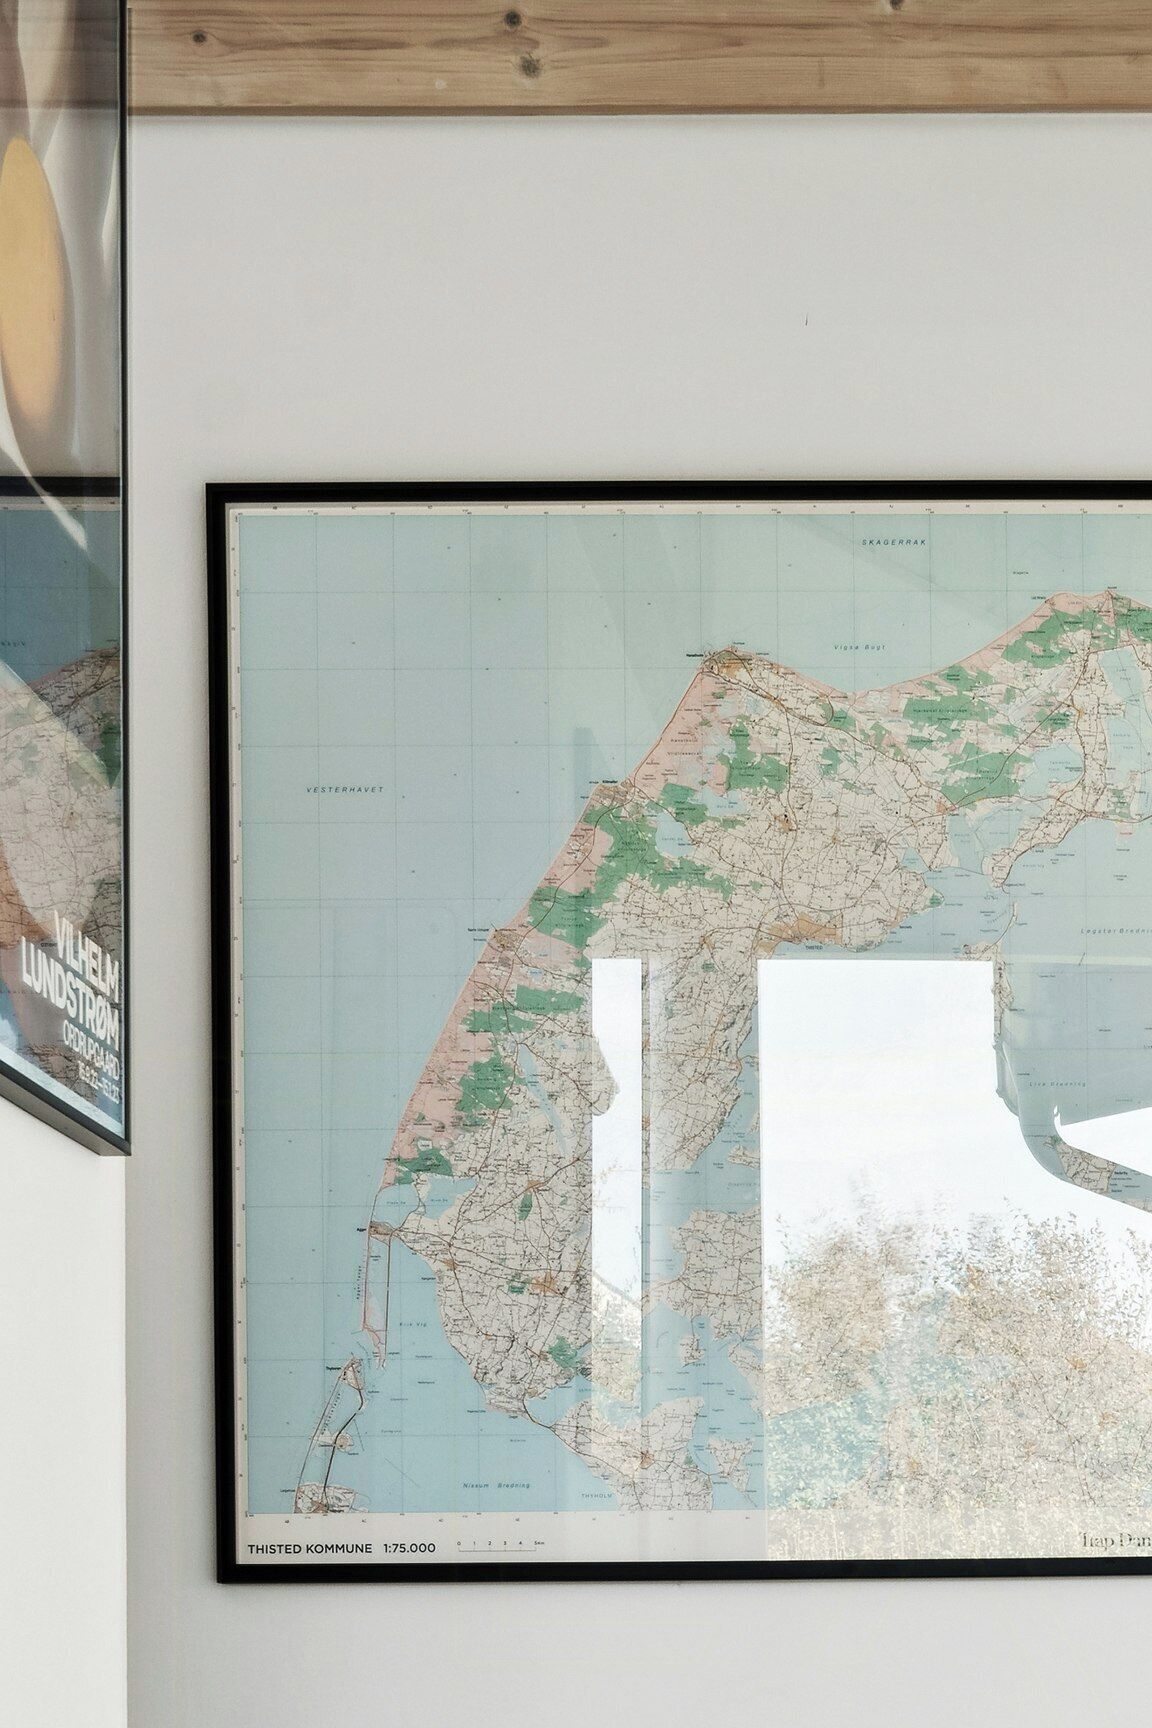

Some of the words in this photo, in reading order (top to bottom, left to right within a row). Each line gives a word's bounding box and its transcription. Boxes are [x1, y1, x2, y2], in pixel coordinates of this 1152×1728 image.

[306, 786, 384, 794] VESTERHAVET
[54, 909, 119, 1003] VILHELM
[22, 935, 119, 1051] LUNDSTRØM
[248, 1544, 302, 1555] THISTED
[306, 1543, 372, 1554] KOMMUNE
[383, 1542, 436, 1554] 1:75.000
